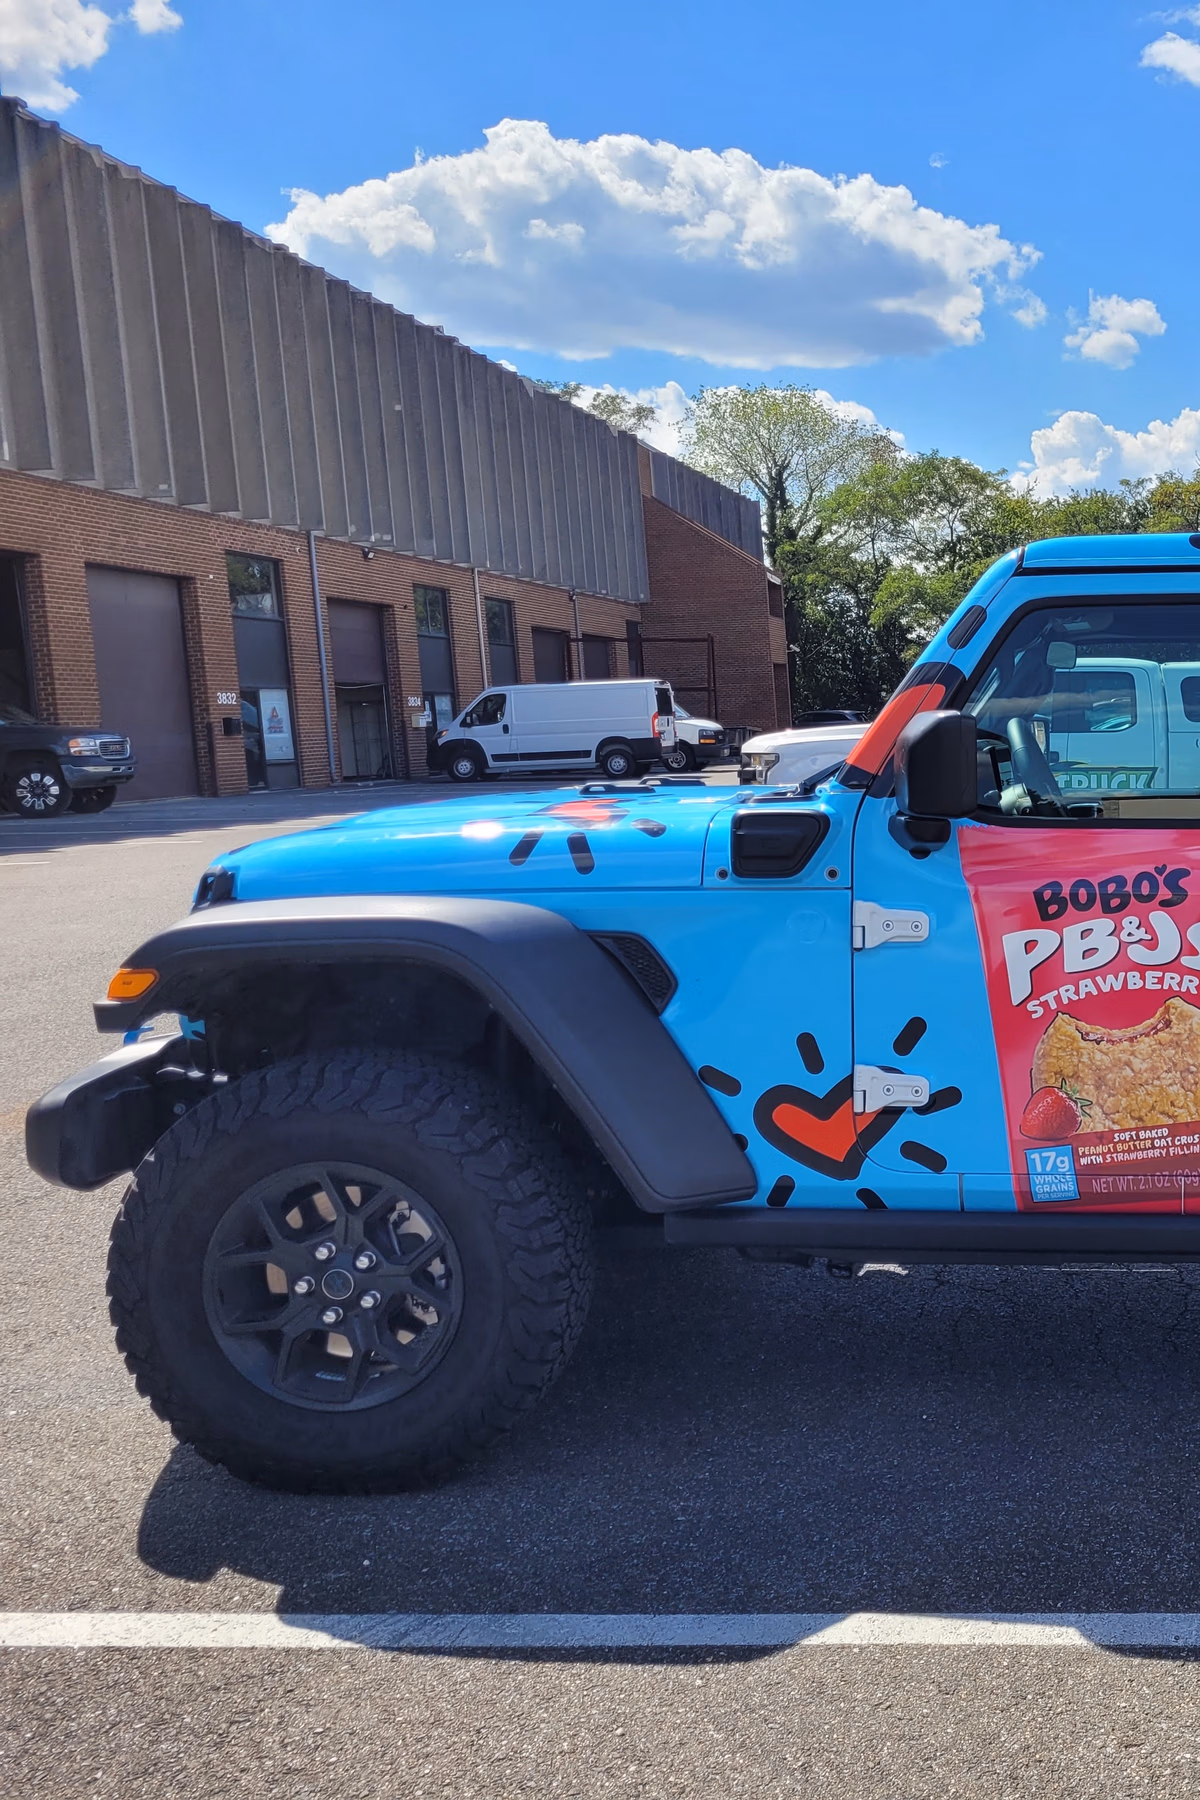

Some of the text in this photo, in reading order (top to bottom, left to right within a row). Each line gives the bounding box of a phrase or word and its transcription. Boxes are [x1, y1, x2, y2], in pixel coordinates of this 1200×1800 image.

[216, 692, 237, 704] 3832
[1113, 1127, 1168, 1142] SOFT BAKED
[1078, 1143, 1114, 1156] PEANUT
[1116, 1139, 1152, 1151] BUTTER
[1154, 1136, 1173, 1147] OAT
[1030, 1151, 1070, 1173] 17g
[1080, 1154, 1104, 1166] WITH
[1105, 1148, 1167, 1163] STRAWBERRY
[1033, 1171, 1072, 1184] WHOLE
[1091, 1177, 1115, 1194] NET
[1116, 1175, 1137, 1192] WT.
[1139, 1175, 1152, 1189] 2.1
[1154, 1172, 1172, 1188] OZ
[1036, 1182, 1074, 1194] GRAINS
